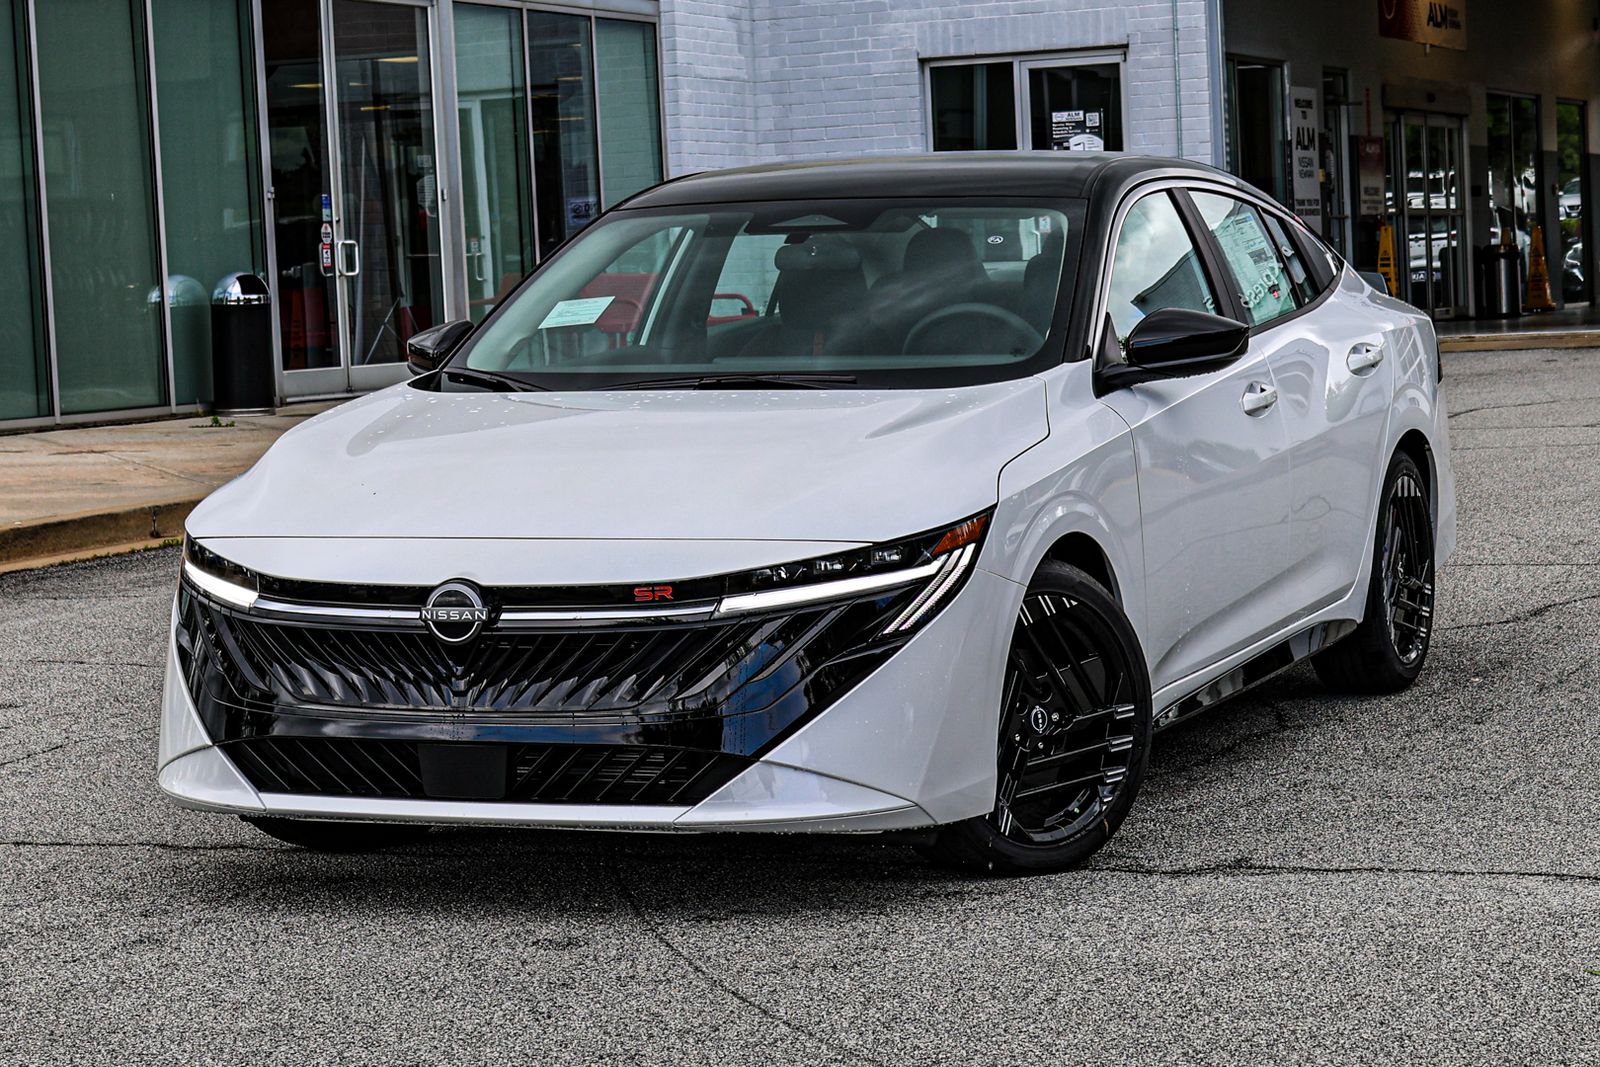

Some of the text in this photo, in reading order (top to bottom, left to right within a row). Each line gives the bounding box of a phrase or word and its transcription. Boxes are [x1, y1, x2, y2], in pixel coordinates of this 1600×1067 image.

[1427, 2, 1448, 30] ALM
[1296, 126, 1315, 151] ALM
[633, 586, 674, 601] SR
[422, 610, 486, 620] NISSAN
